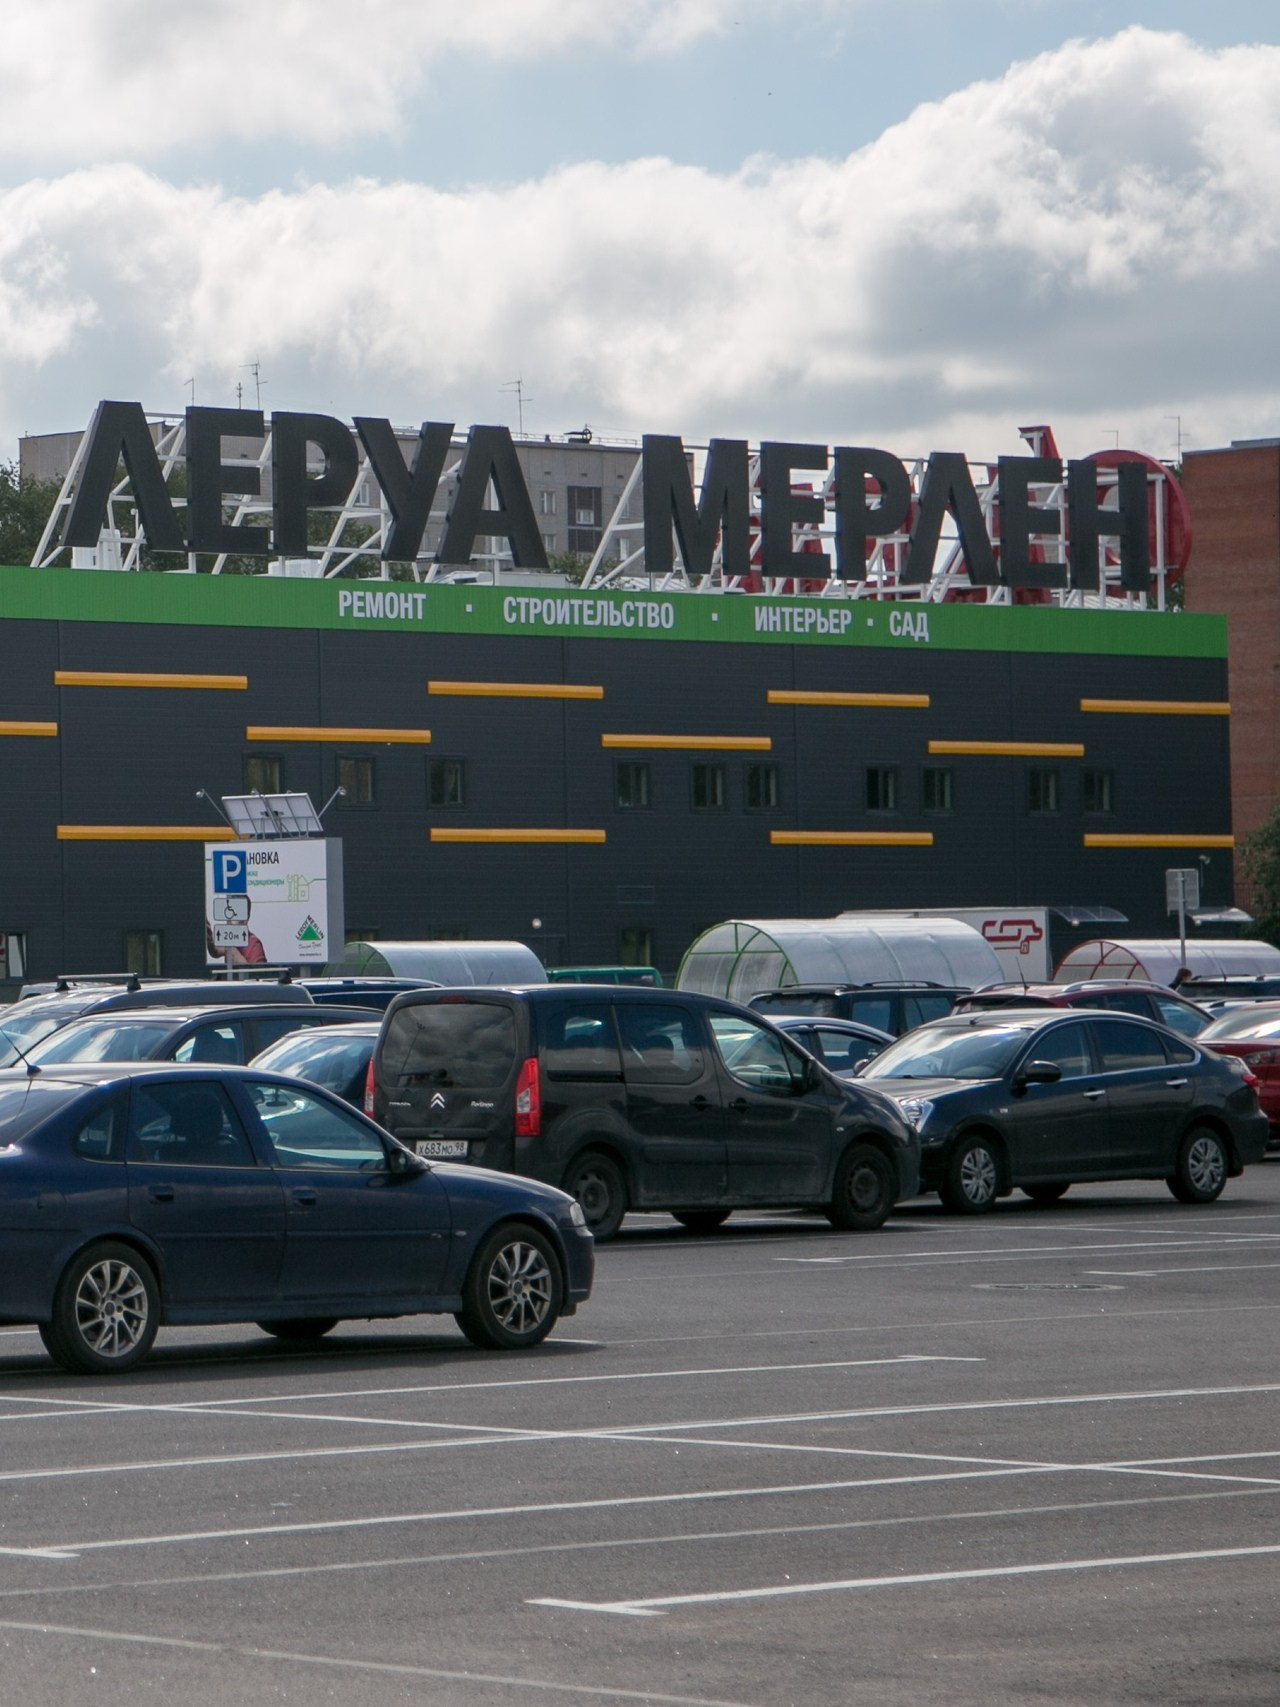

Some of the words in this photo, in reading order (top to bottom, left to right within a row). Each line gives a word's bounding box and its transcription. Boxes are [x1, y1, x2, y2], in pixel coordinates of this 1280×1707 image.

[60, 400, 550, 569] ЛЕРУА
[642, 433, 1151, 593] МЕРЛЕН
[338, 590, 426, 620] РЕМОНТ
[503, 596, 675, 629] СТРОИТЕЛЬСТВО
[754, 606, 852, 634] ИНТЕРЬЕР
[889, 611, 929, 642] САД
[221, 854, 242, 890] P
[223, 931, 239, 940] 20м
